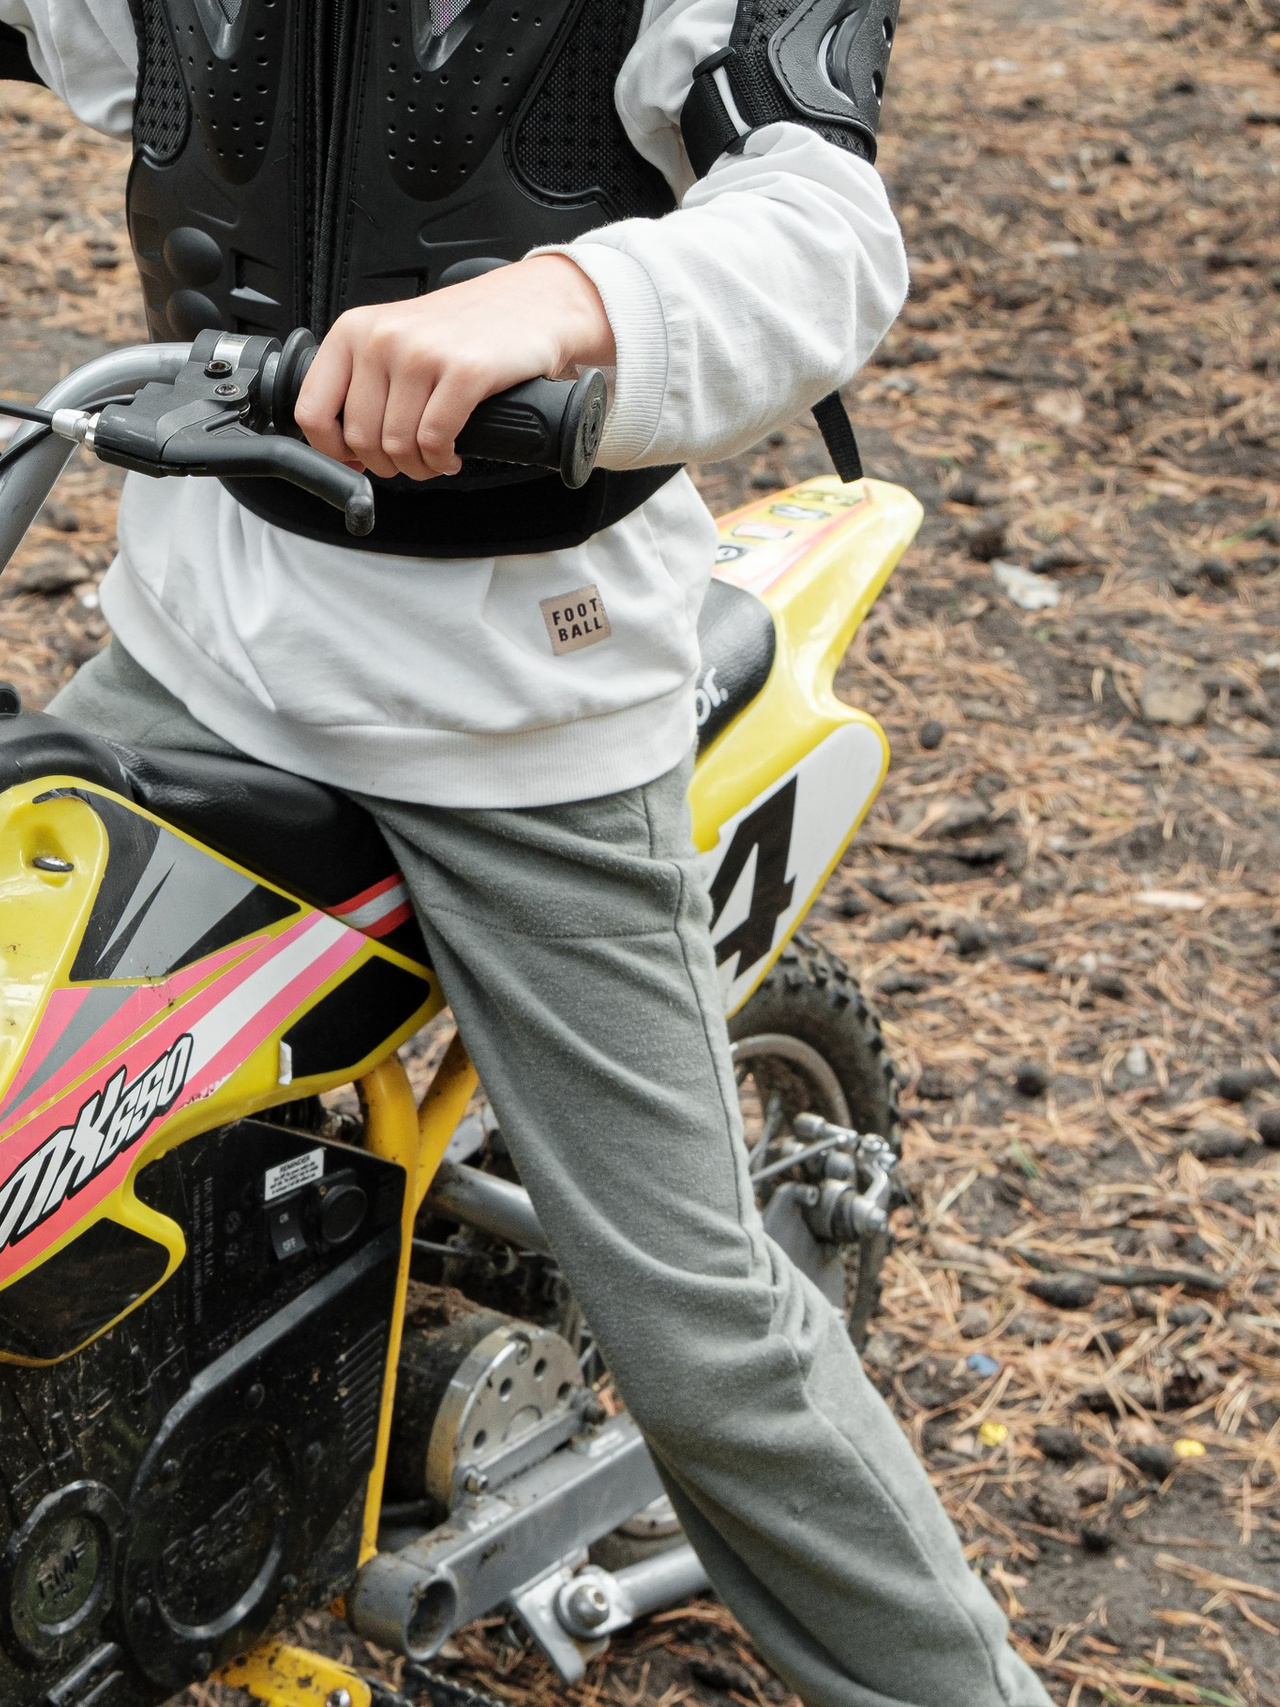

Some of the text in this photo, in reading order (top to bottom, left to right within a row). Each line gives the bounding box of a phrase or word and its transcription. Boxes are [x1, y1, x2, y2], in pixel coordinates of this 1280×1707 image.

[552, 598, 597, 626] FOOT
[558, 617, 603, 642] BALL
[709, 773, 798, 972] 4
